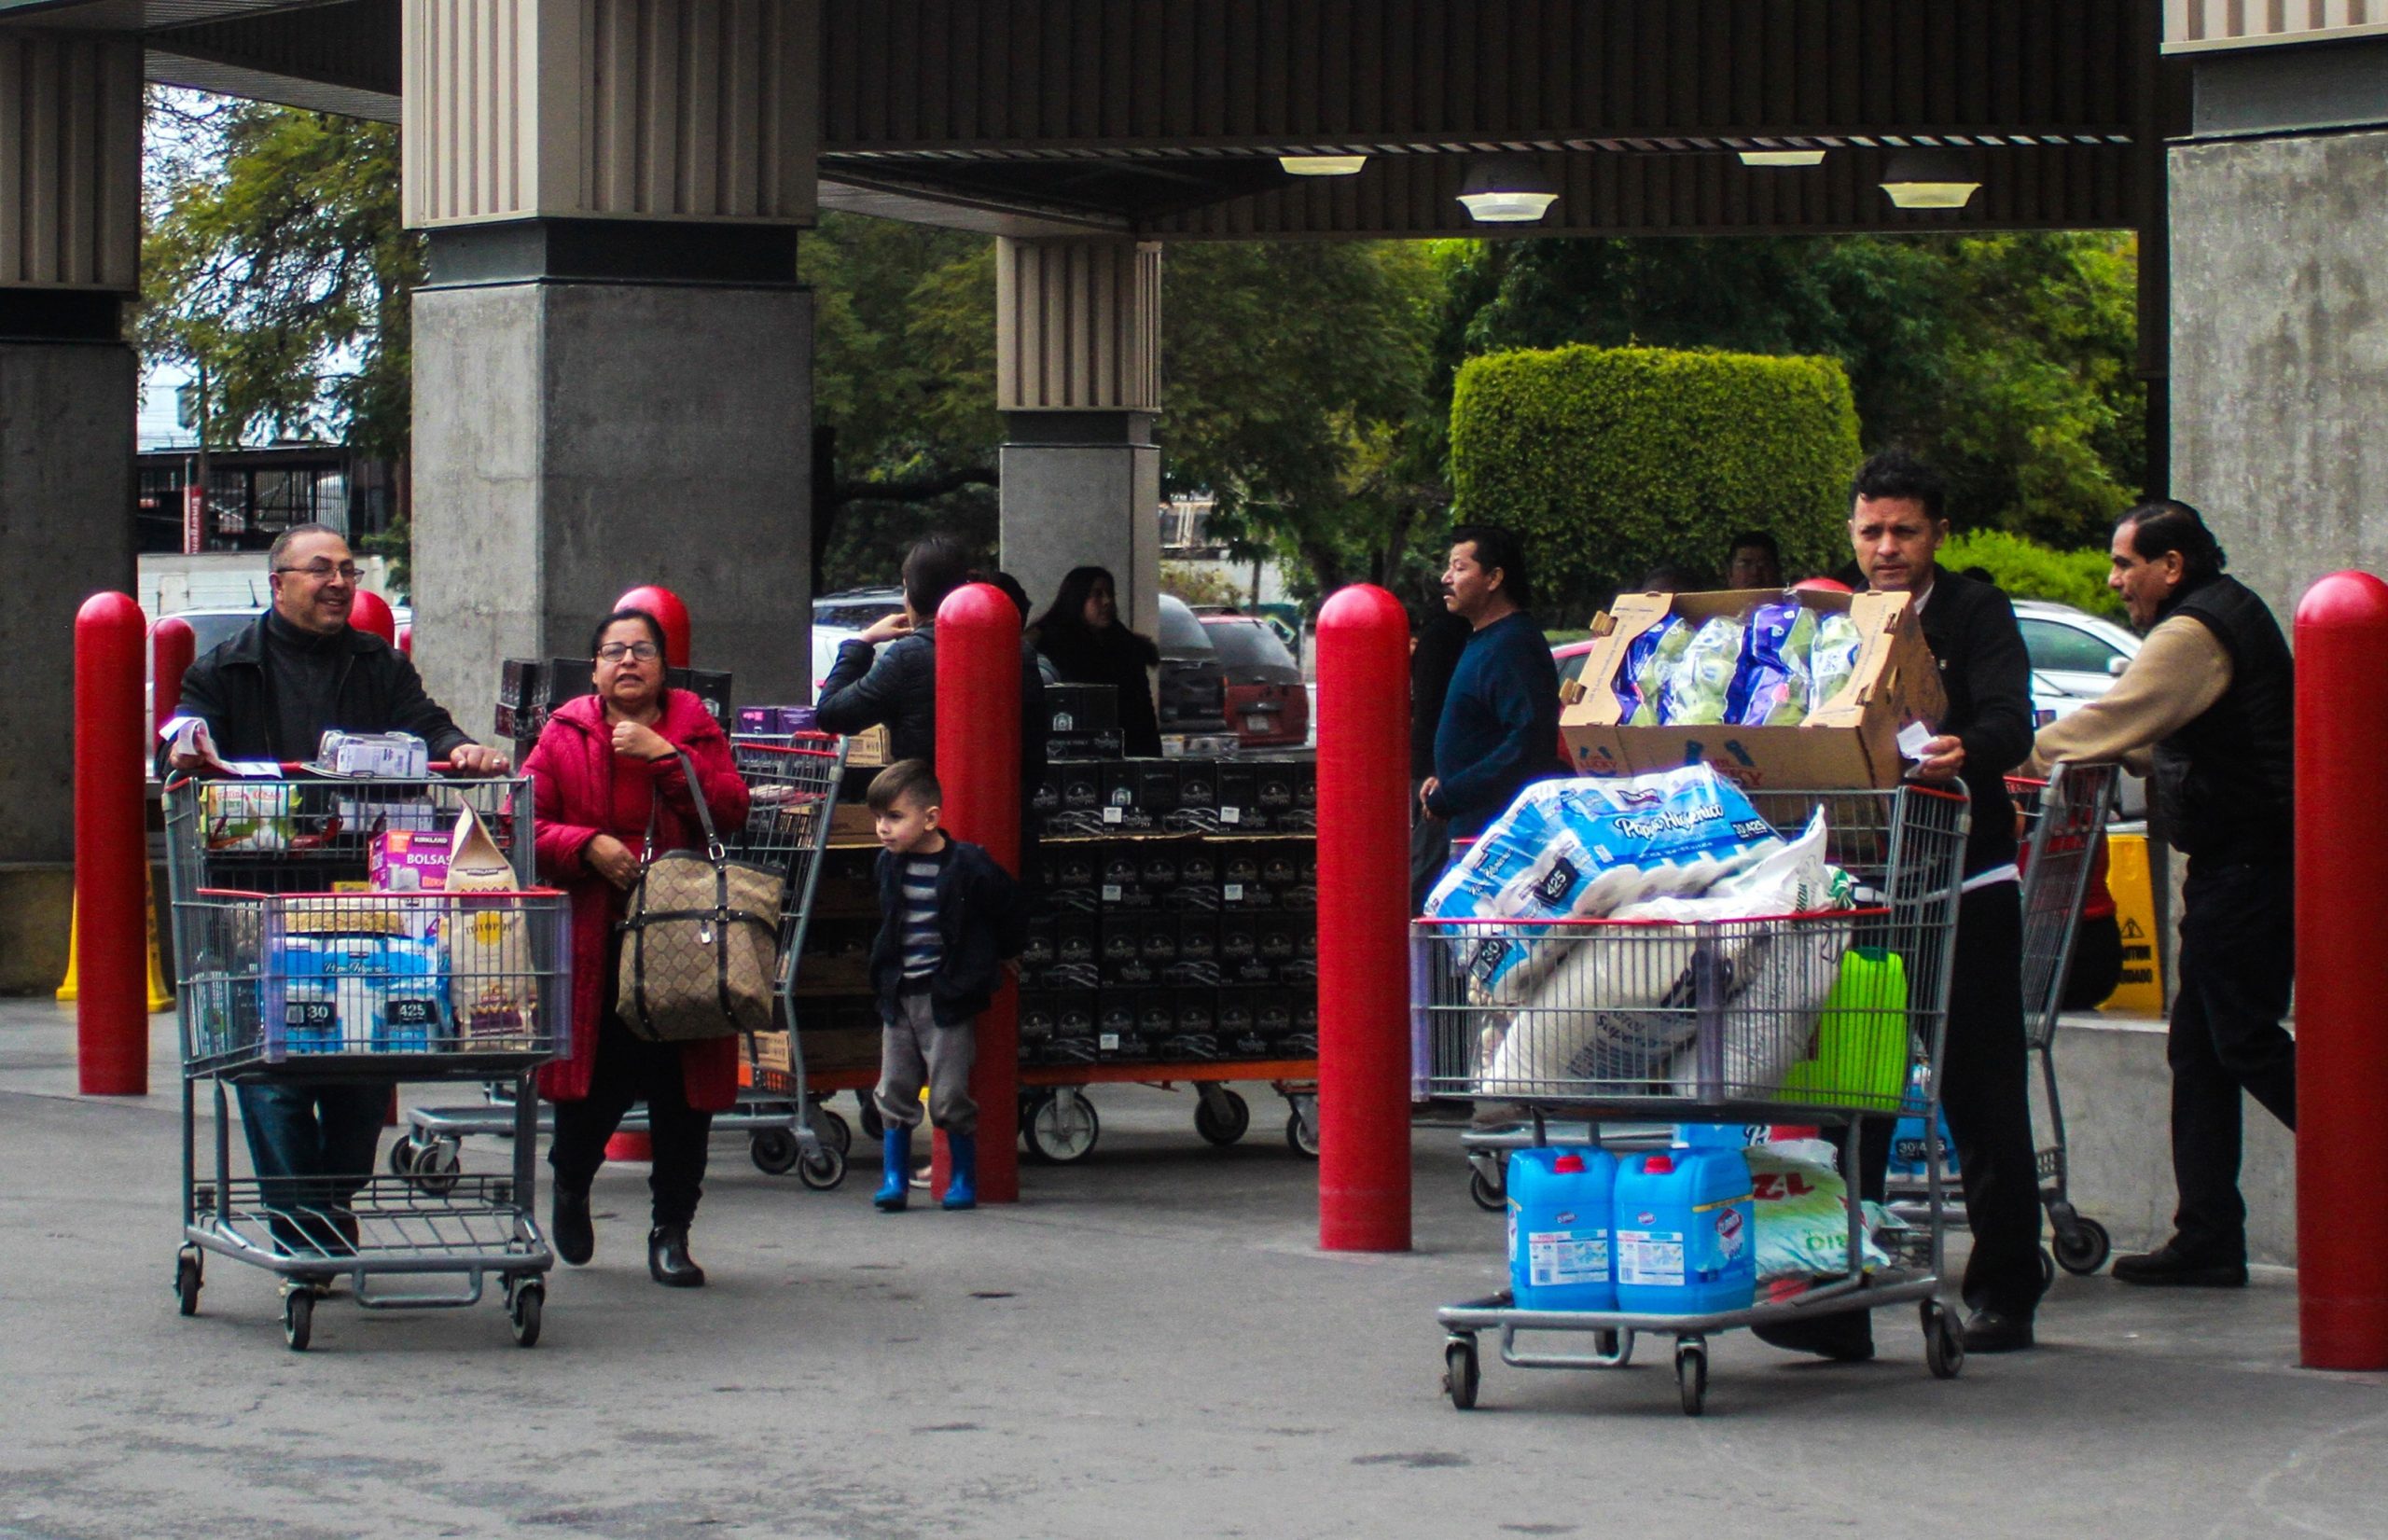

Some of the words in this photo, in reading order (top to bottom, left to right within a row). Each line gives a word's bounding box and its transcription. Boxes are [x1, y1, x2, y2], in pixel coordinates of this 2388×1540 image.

[1547, 870, 1567, 896] 425
[1481, 939, 1500, 962] 30
[307, 1006, 329, 1019] 30
[398, 1004, 425, 1018] 425
[1899, 1142, 1916, 1154] 30
[1919, 1140, 1946, 1152] 45
